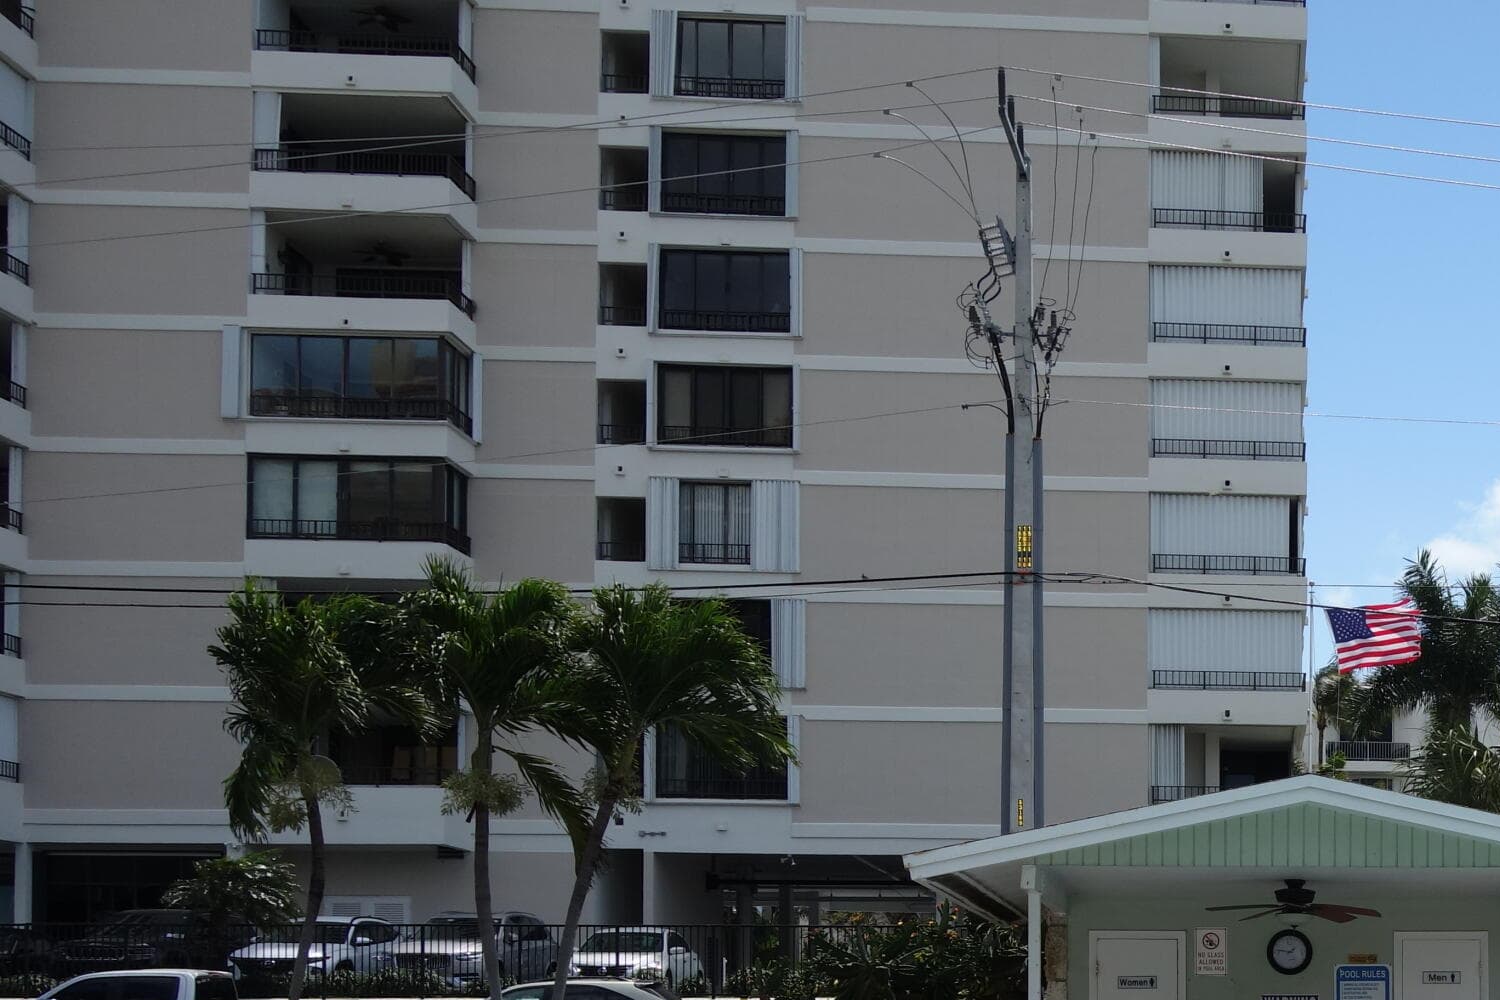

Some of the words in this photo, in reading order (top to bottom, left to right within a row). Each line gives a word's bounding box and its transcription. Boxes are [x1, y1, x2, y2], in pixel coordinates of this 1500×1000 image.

[1340, 969, 1360, 978] POOL
[1362, 970, 1386, 978] RULES
[1428, 973, 1447, 982] Men
[1119, 978, 1148, 986] Women
